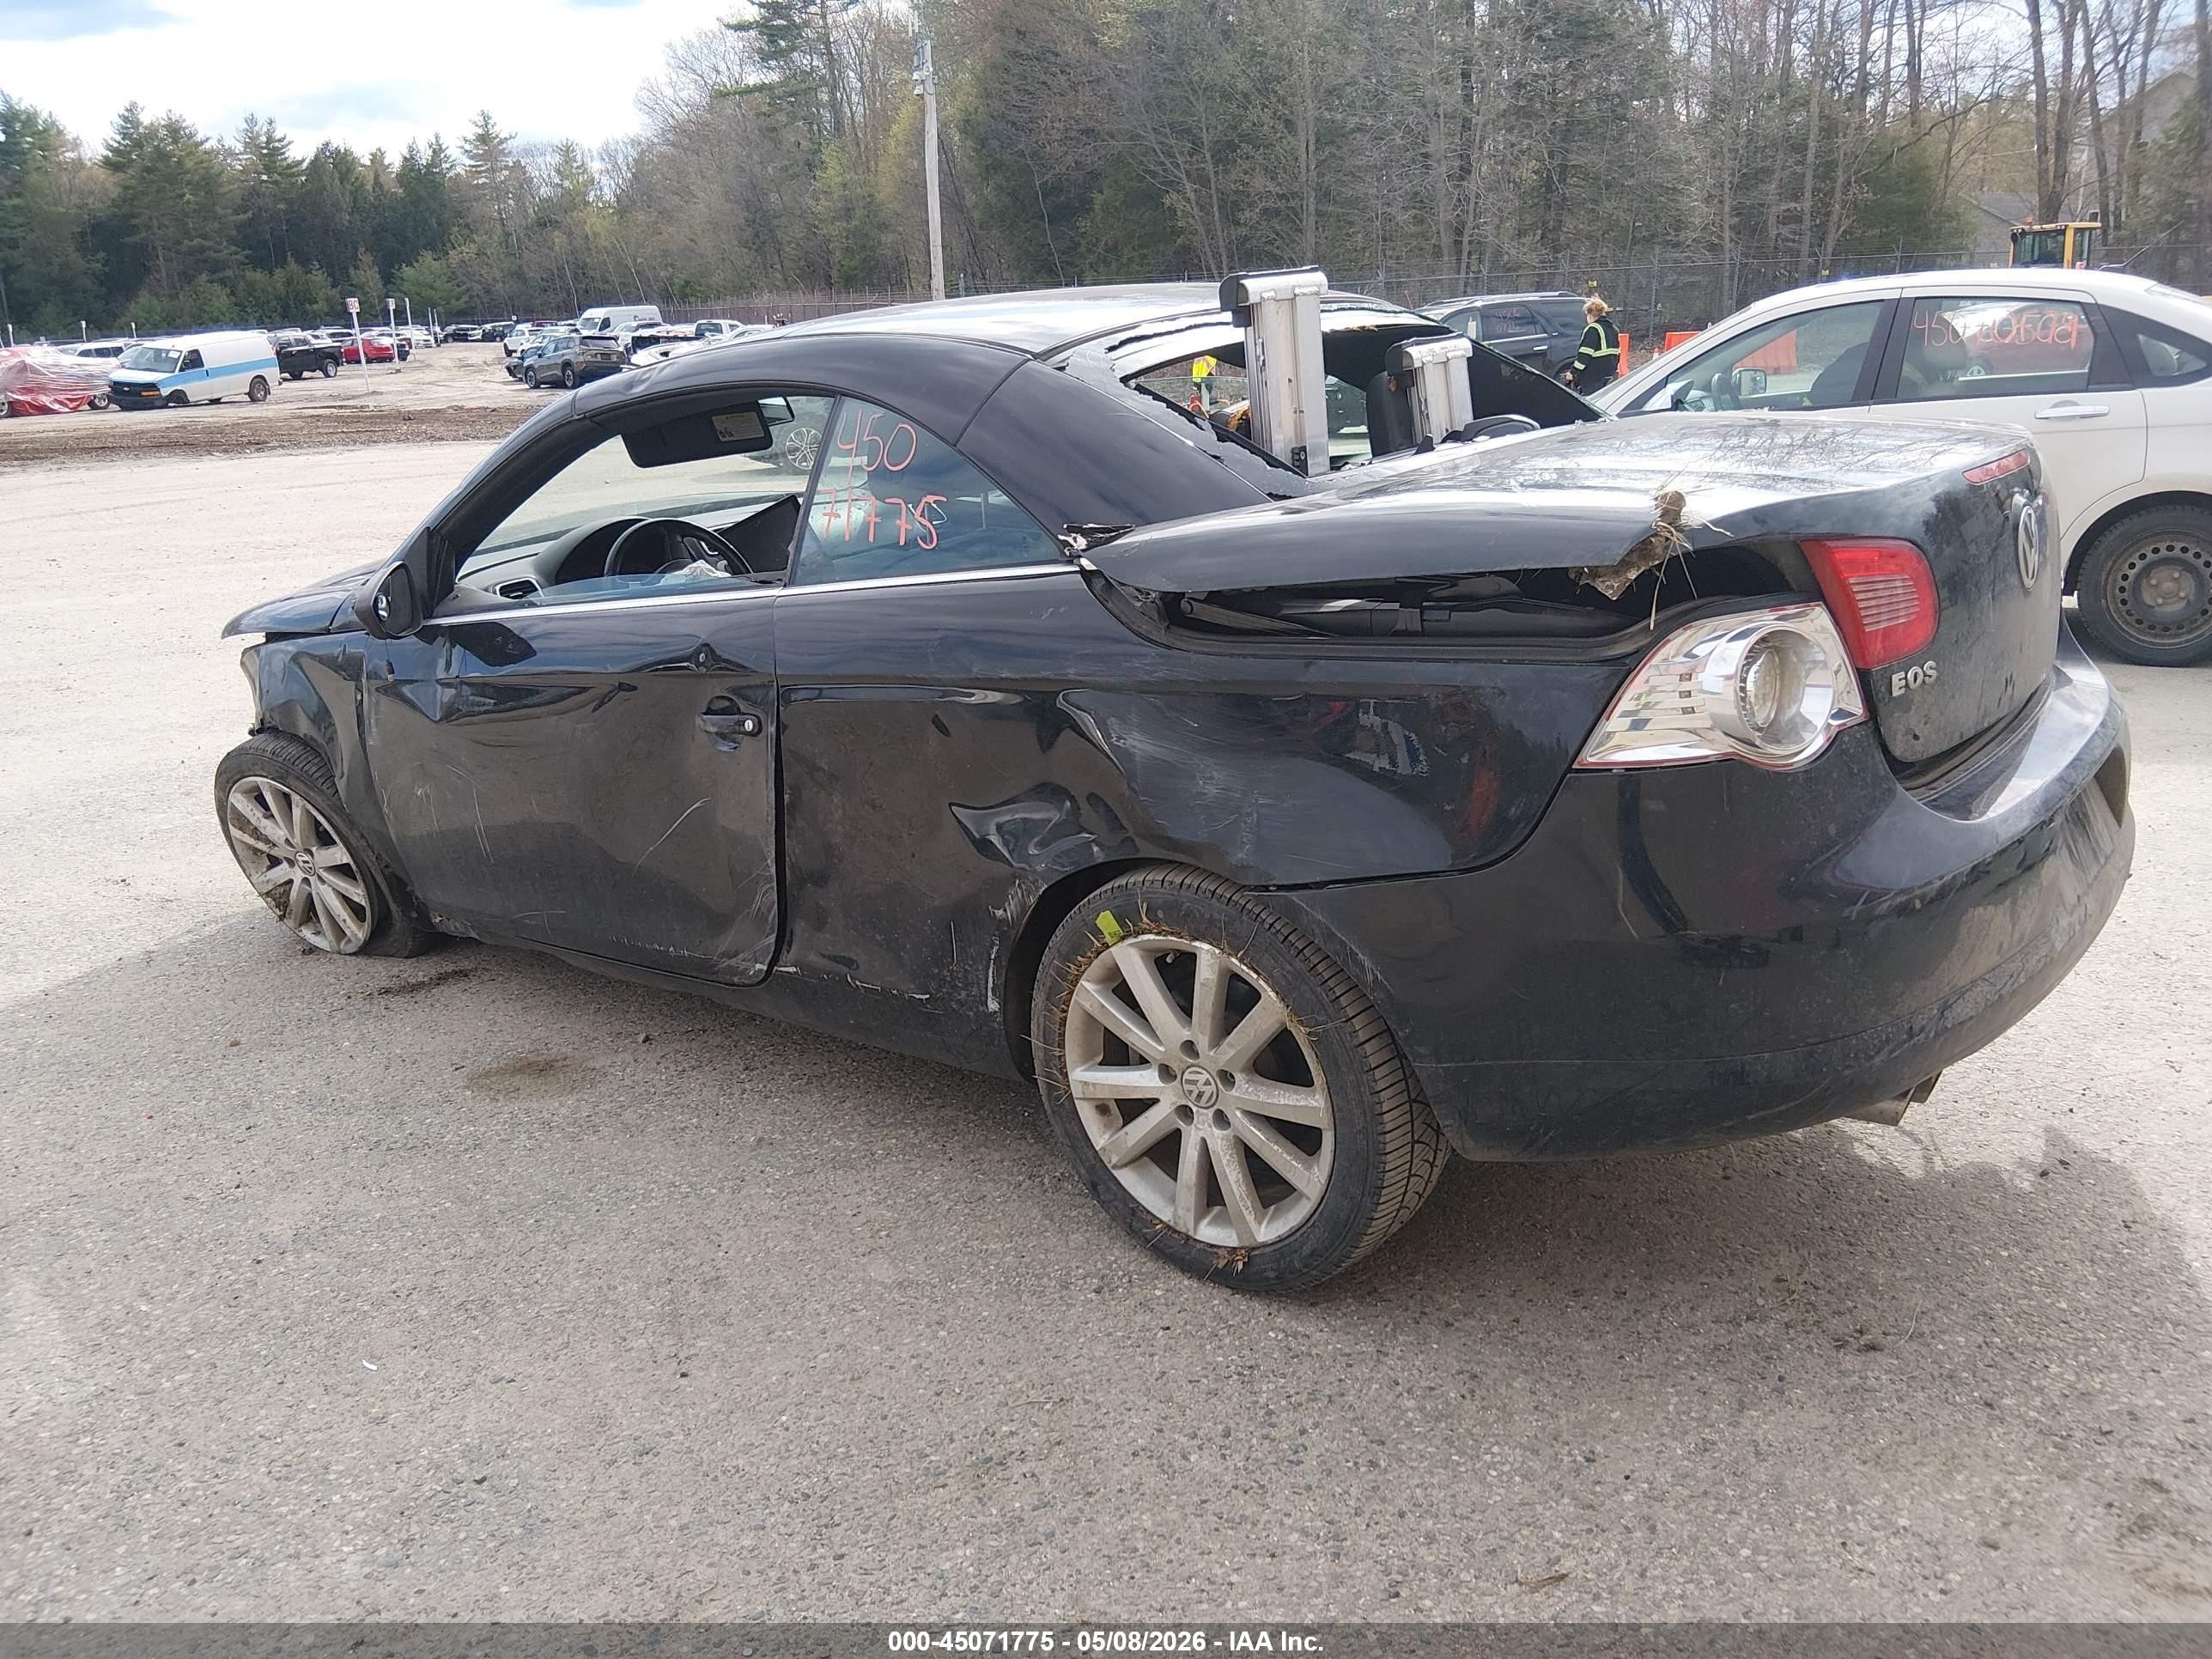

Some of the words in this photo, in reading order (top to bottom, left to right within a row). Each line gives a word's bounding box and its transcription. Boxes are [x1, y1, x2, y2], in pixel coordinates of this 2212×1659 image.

[837, 409, 918, 481] 450
[817, 487, 948, 550] 71775
[1891, 660, 1938, 697] EOS
